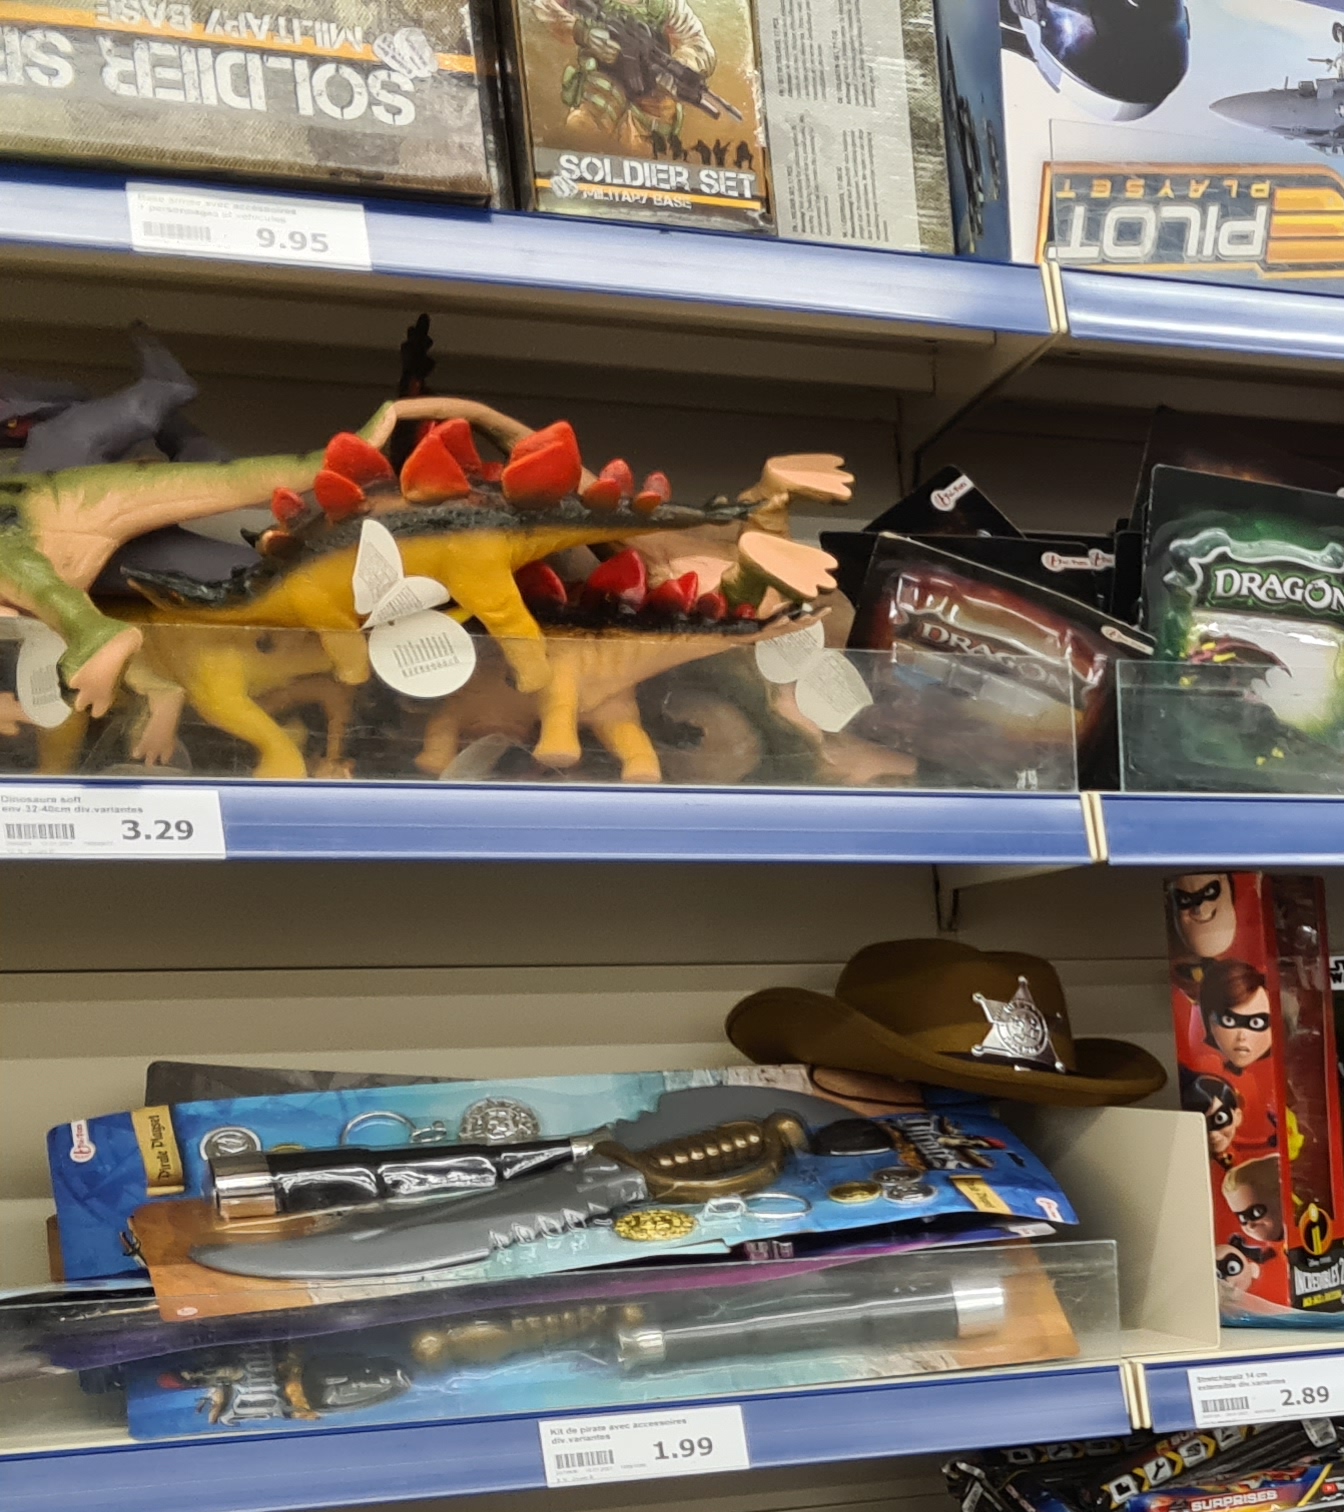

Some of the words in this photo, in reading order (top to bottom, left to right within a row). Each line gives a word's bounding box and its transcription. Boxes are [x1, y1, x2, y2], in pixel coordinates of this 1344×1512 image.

[98, 34, 416, 126] SOLDIER
[559, 154, 690, 192] SOLDIER
[699, 170, 756, 199] SET
[1054, 178, 1270, 199] PLAYSET
[583, 187, 649, 206] MILITARY
[653, 193, 692, 210] BASE
[256, 226, 330, 254] 9.95
[1046, 203, 1270, 261] PILOT
[922, 621, 1071, 694] DRAGON
[121, 819, 195, 841] 3.29
[148, 1115, 166, 1150] Playset
[157, 1150, 172, 1179] Pirate
[1280, 1386, 1331, 1408] 2.89
[550, 1428, 566, 1438] Kit
[580, 1425, 608, 1436] pirate
[610, 1423, 631, 1432] avec
[633, 1418, 687, 1430] accessoires
[653, 1436, 714, 1462] 1.99
[1190, 1490, 1278, 1512] SURPRISES
